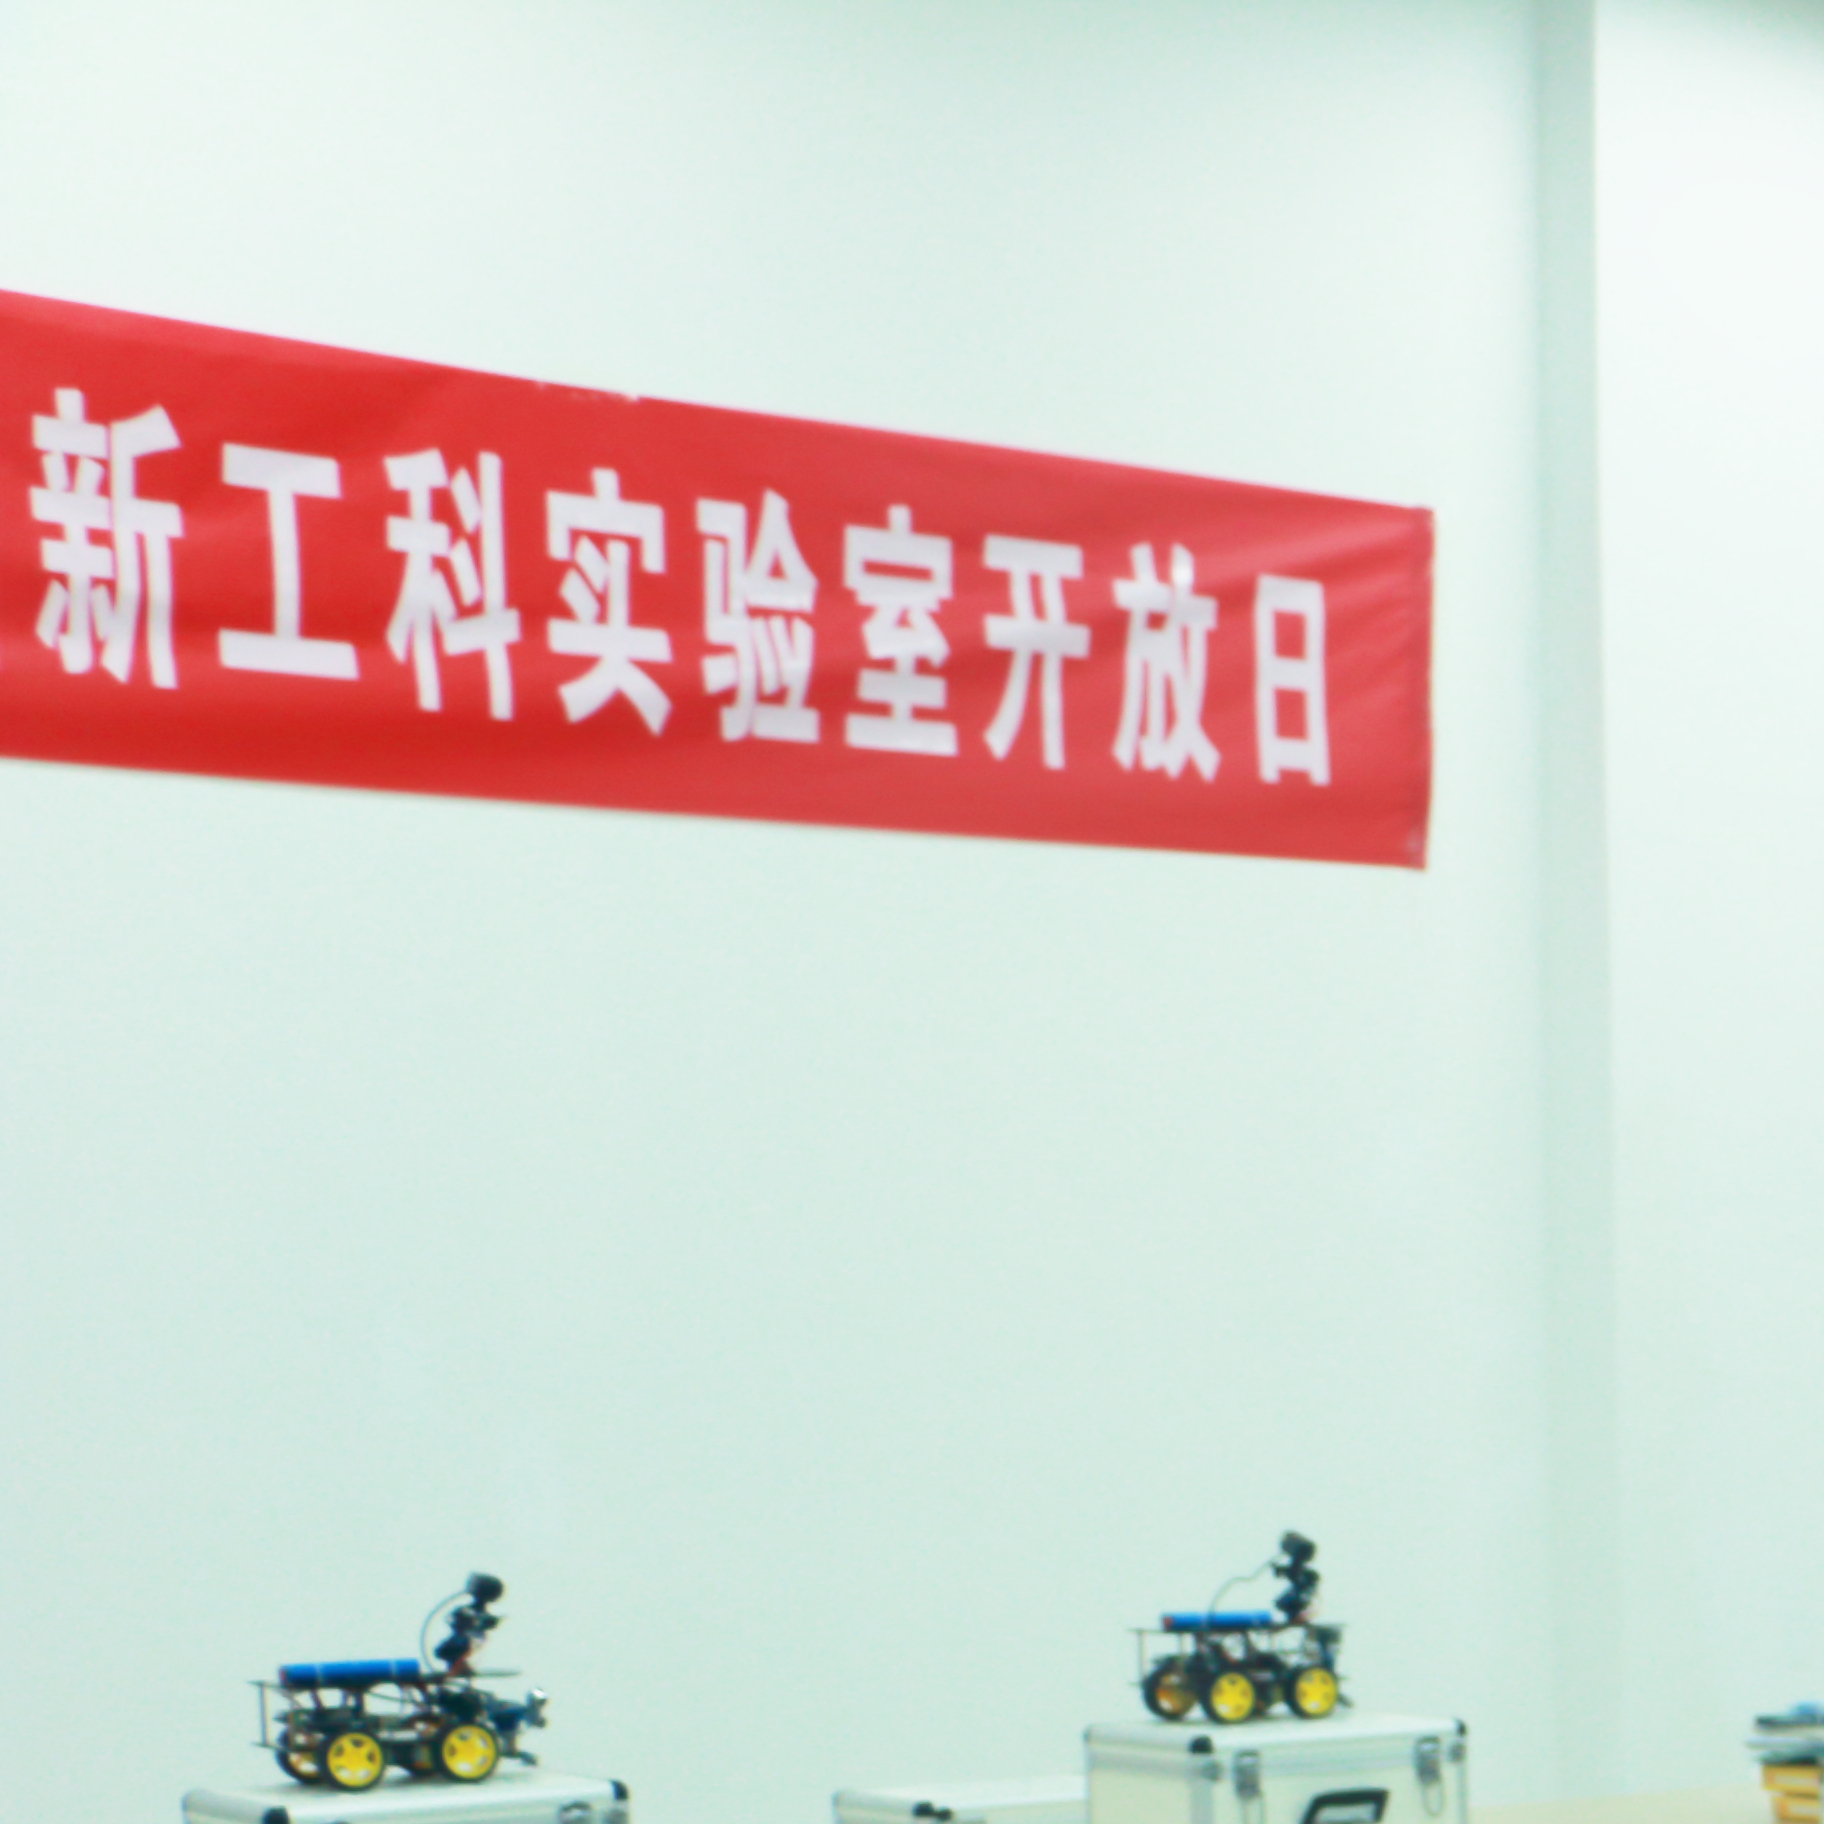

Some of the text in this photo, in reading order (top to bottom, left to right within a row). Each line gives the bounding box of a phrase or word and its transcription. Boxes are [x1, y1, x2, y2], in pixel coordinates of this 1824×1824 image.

[29, 387, 1333, 789] 新工科实验室开放日
